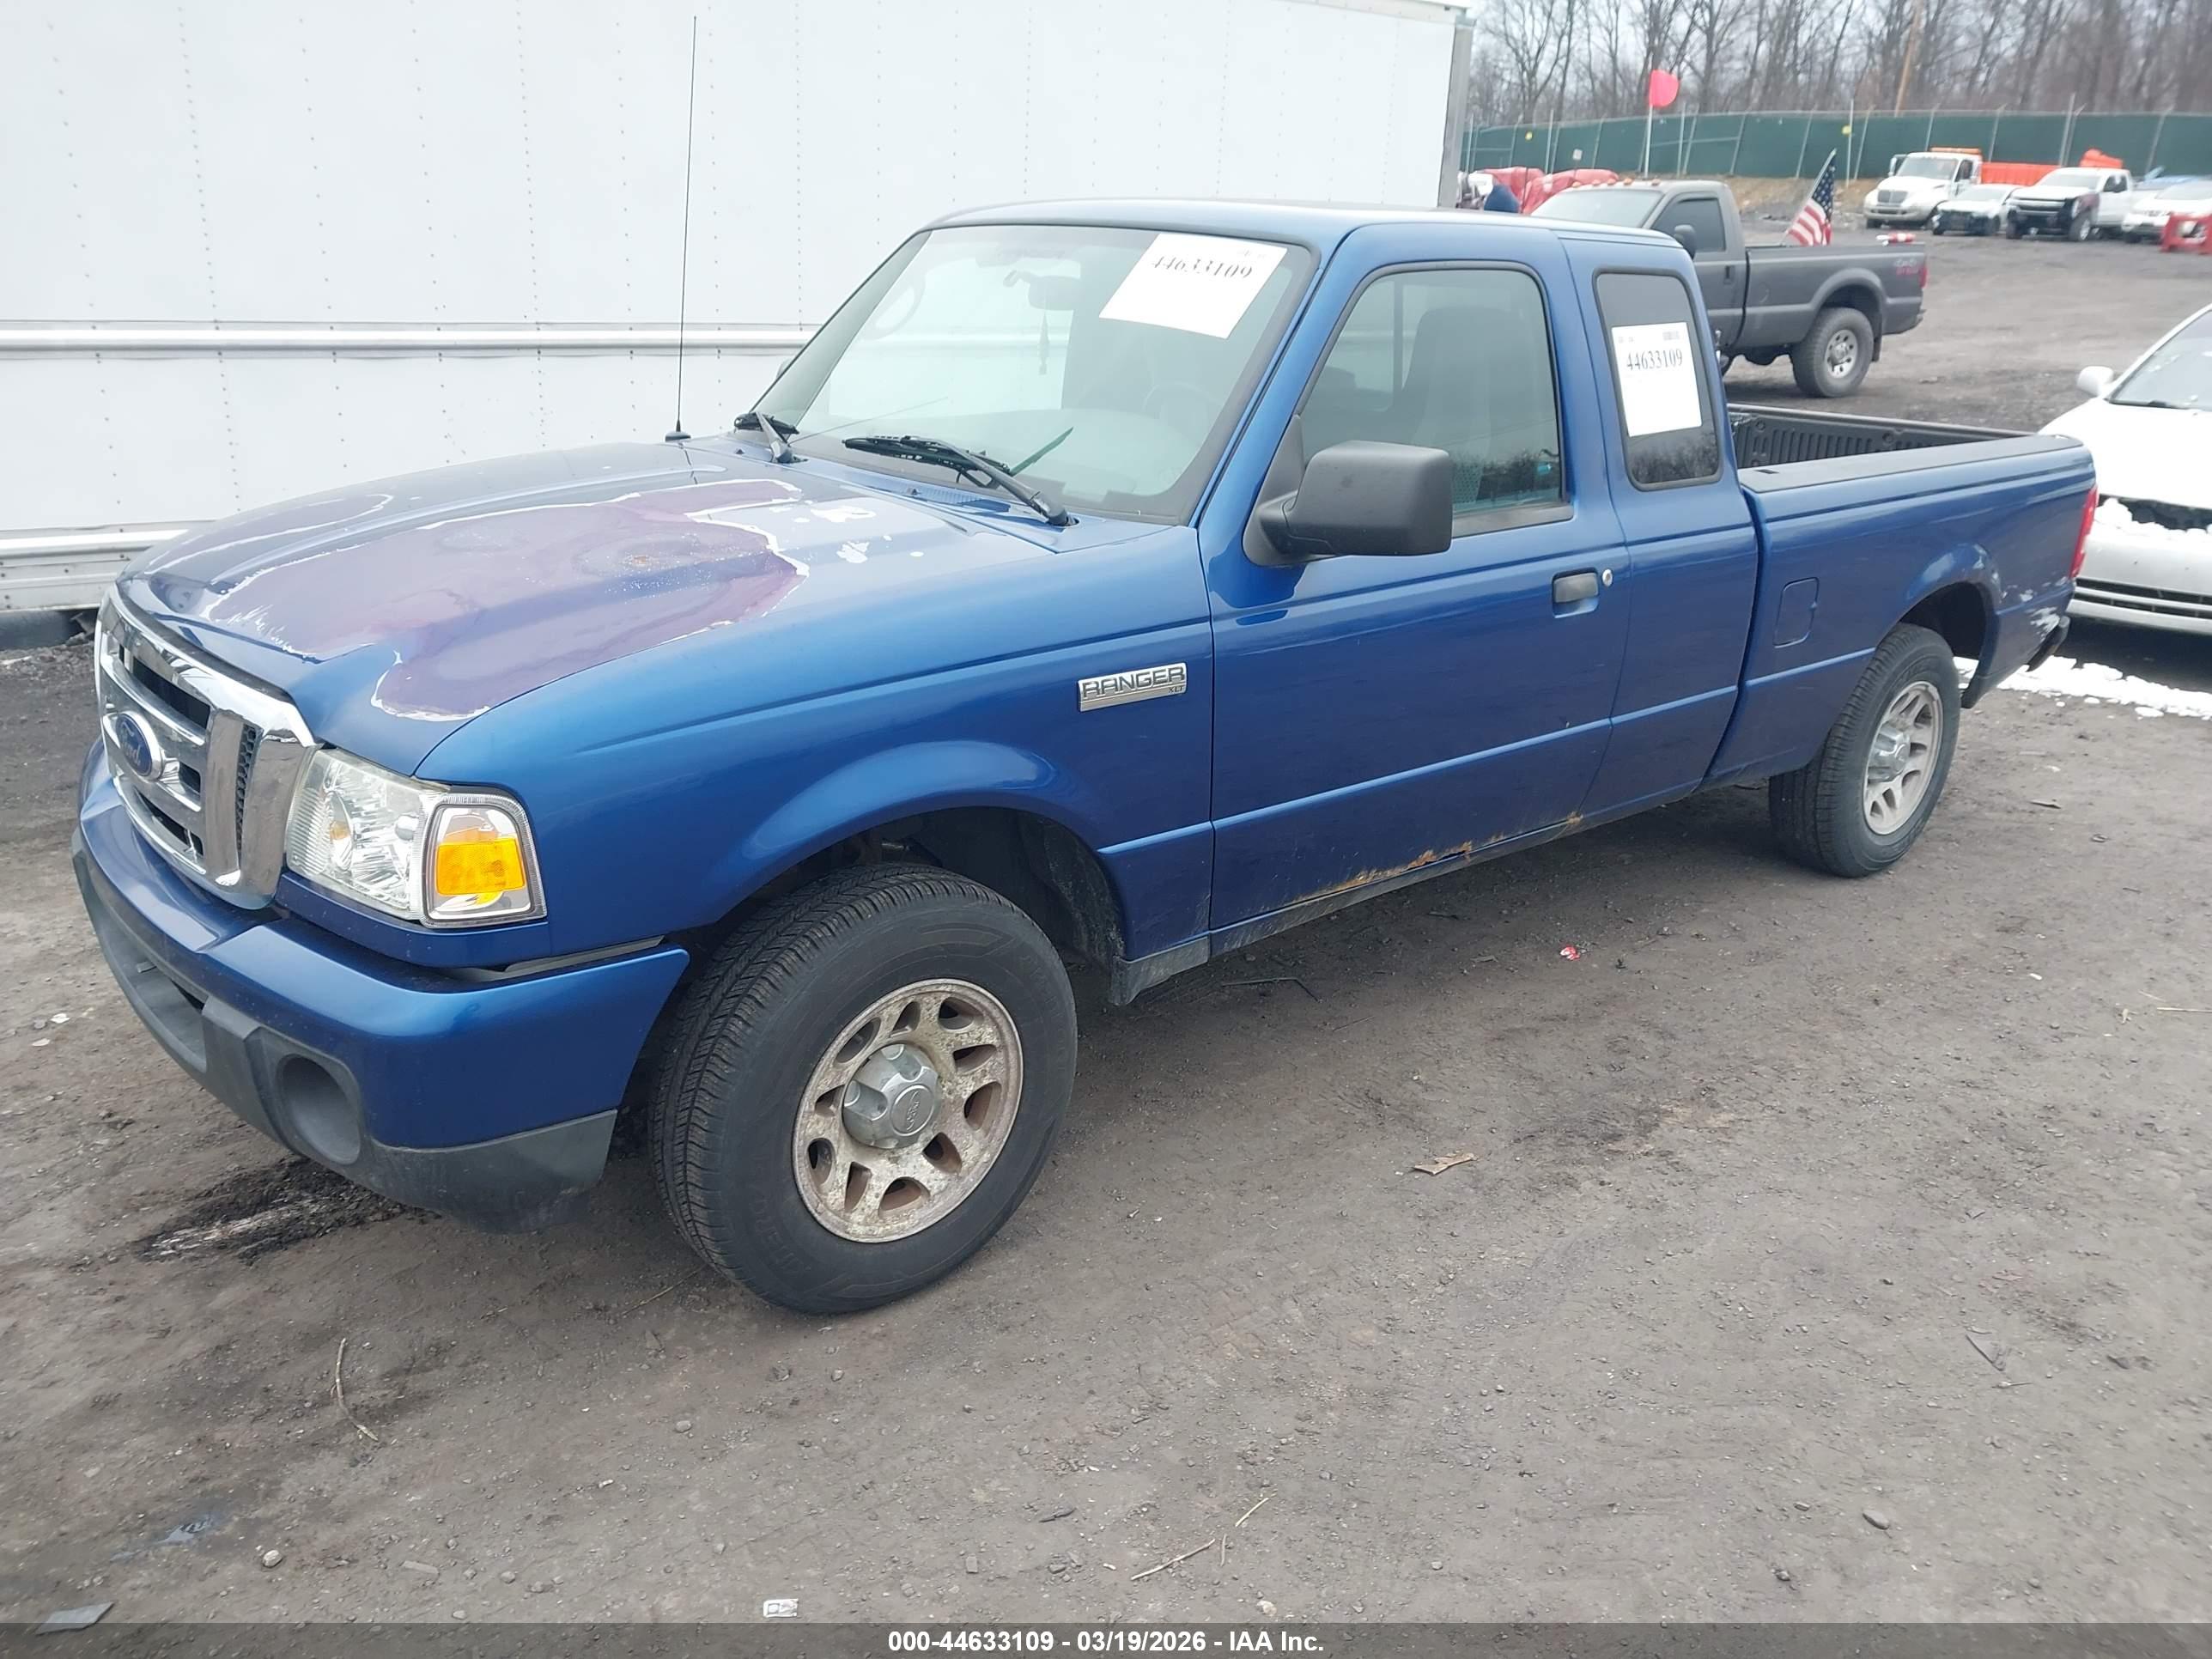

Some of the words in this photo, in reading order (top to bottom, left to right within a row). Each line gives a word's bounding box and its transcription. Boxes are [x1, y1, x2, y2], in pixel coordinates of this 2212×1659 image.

[1151, 255, 1253, 278] 44633109
[1626, 349, 1683, 371] 44633109
[1082, 665, 1185, 698] RANGER
[1168, 684, 1184, 694] XLT
